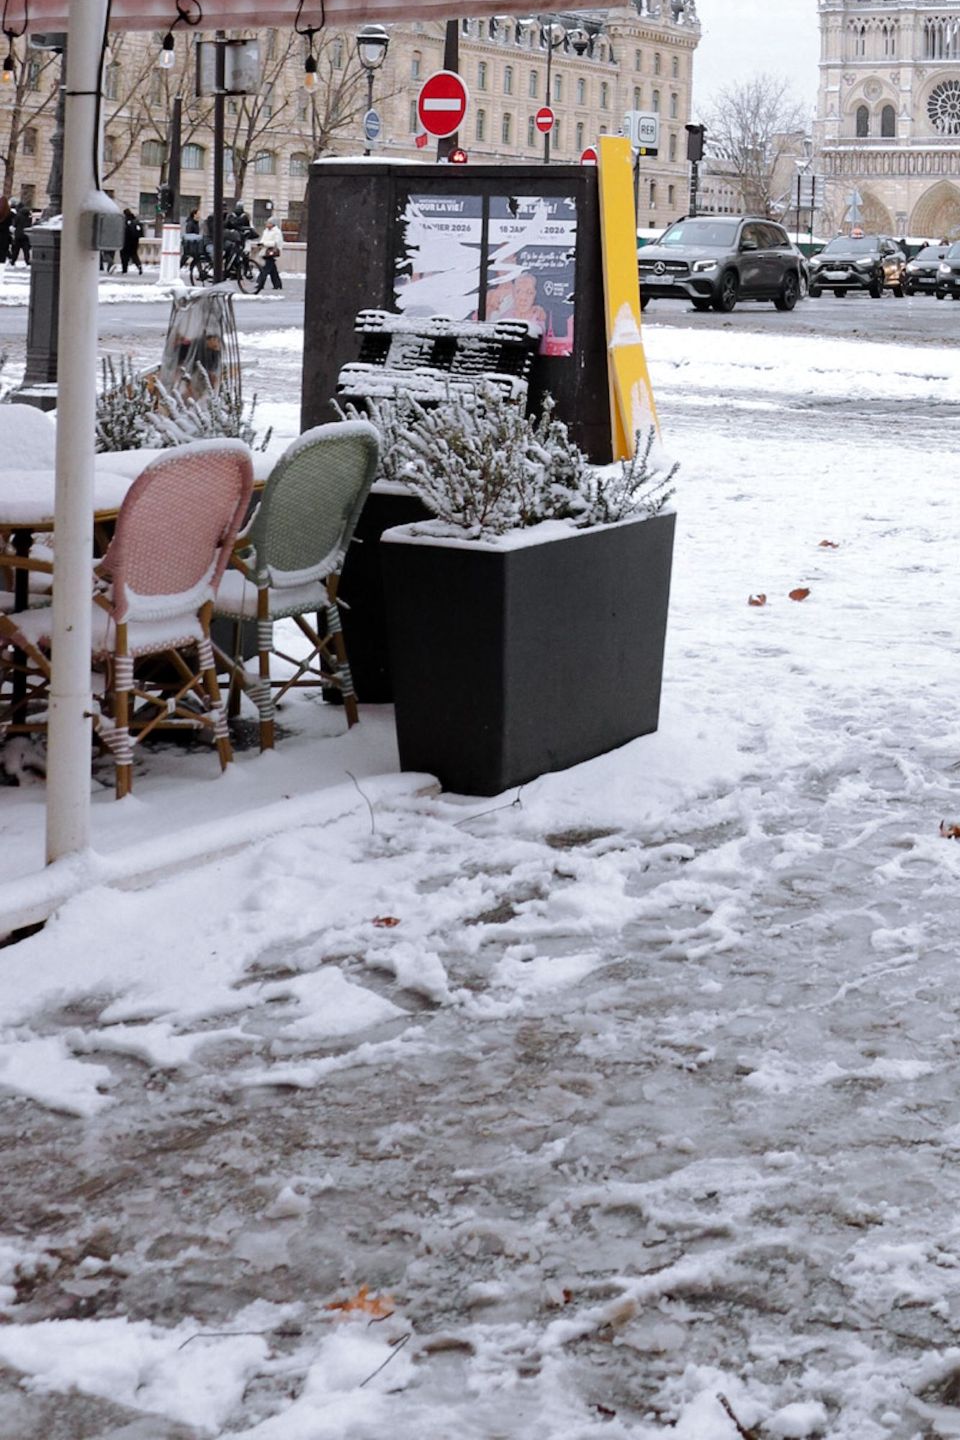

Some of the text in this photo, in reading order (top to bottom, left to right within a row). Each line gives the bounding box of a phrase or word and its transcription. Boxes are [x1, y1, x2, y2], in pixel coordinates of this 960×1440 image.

[641, 125, 655, 135] RER
[451, 224, 471, 232] 2026
[544, 226, 565, 234] 2026
